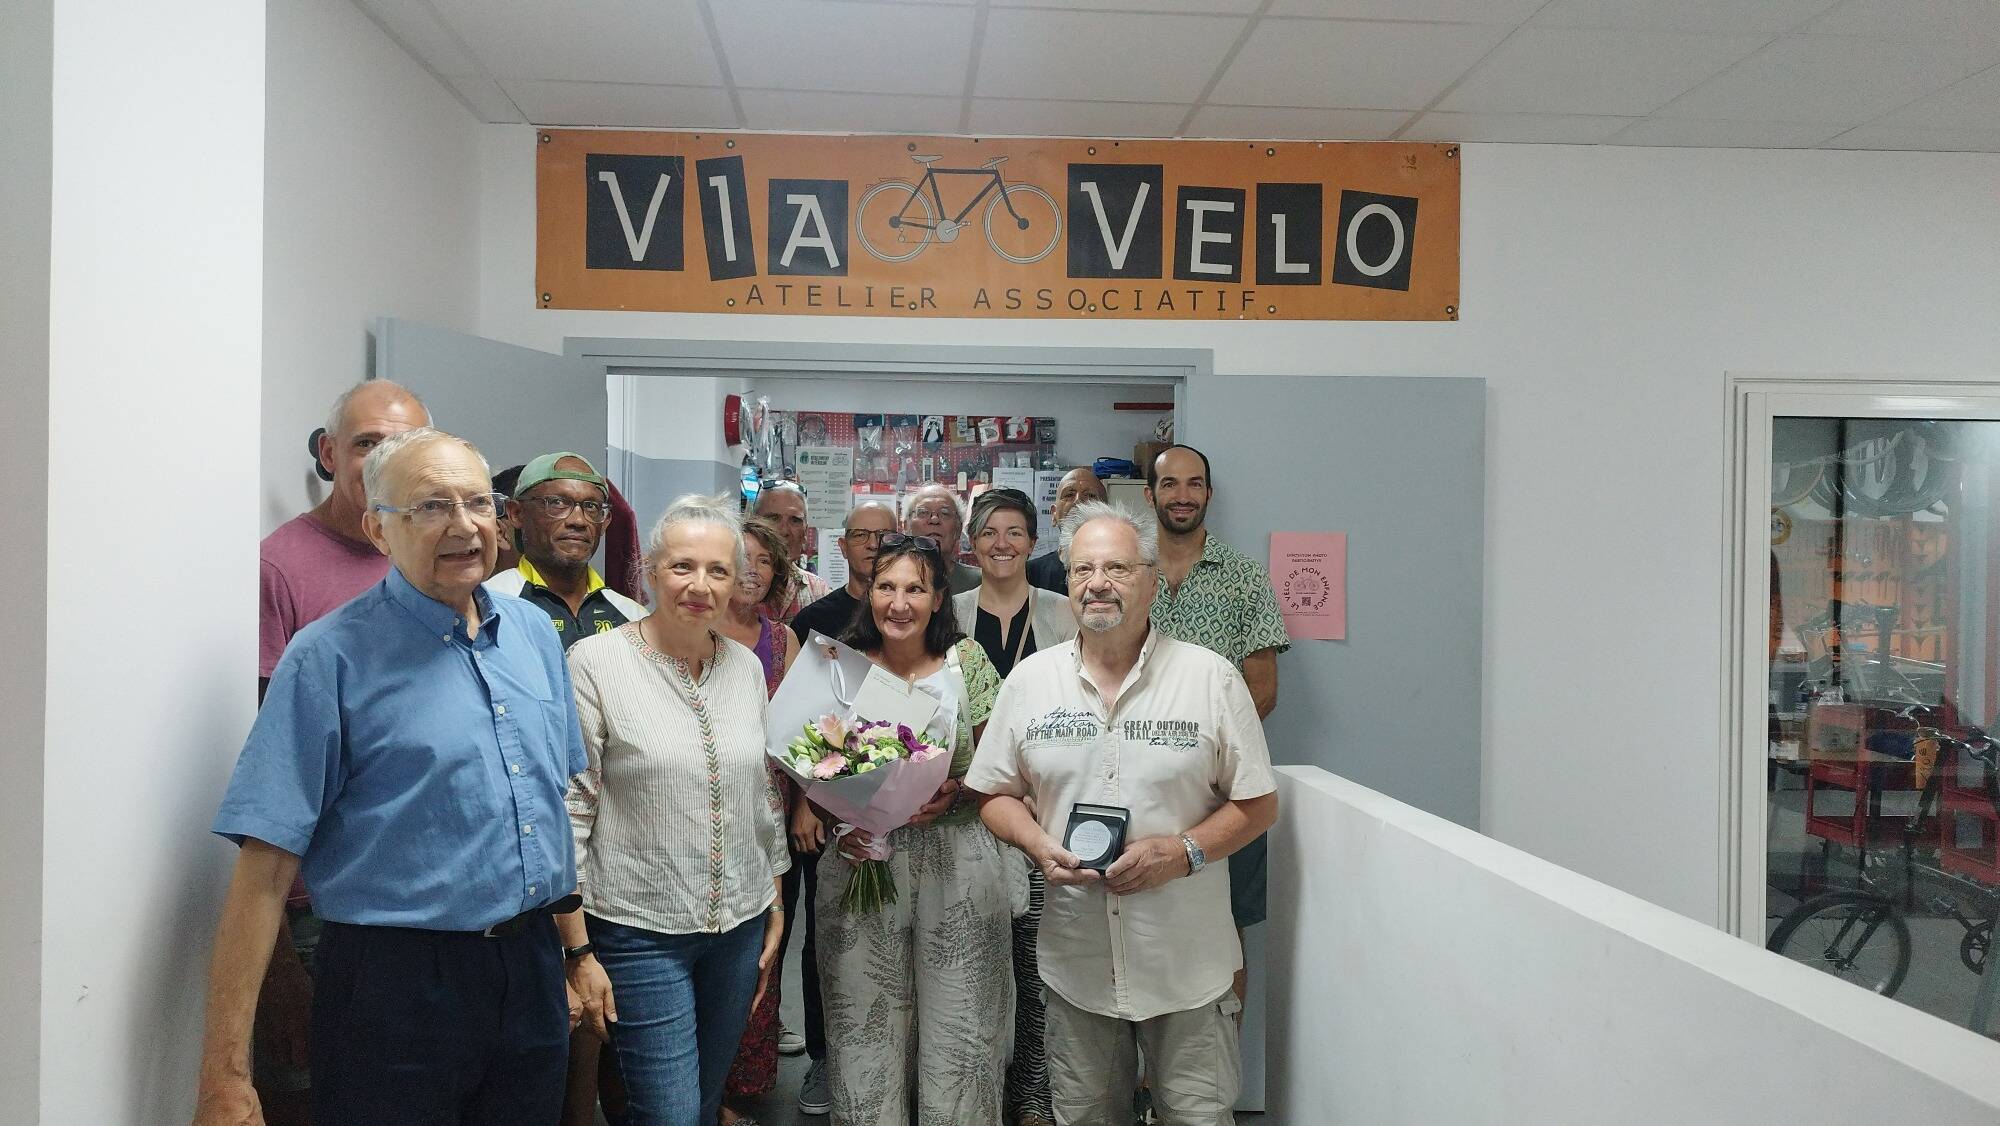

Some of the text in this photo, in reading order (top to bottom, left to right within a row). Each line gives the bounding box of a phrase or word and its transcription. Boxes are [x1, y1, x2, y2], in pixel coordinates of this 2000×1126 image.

[599, 171, 1404, 277] VIA VELO
[746, 284, 1256, 312] ATELIER ASSOCIATIF
[1289, 569, 1300, 580] DE
[1301, 567, 1321, 576] MON
[1312, 575, 1330, 611] ENFANCE
[1026, 726, 1098, 741] OFF THE MAIN ROAD
[1124, 720, 1200, 732] GREAT OUTDOOR
[1124, 730, 1151, 741] TRAIL
